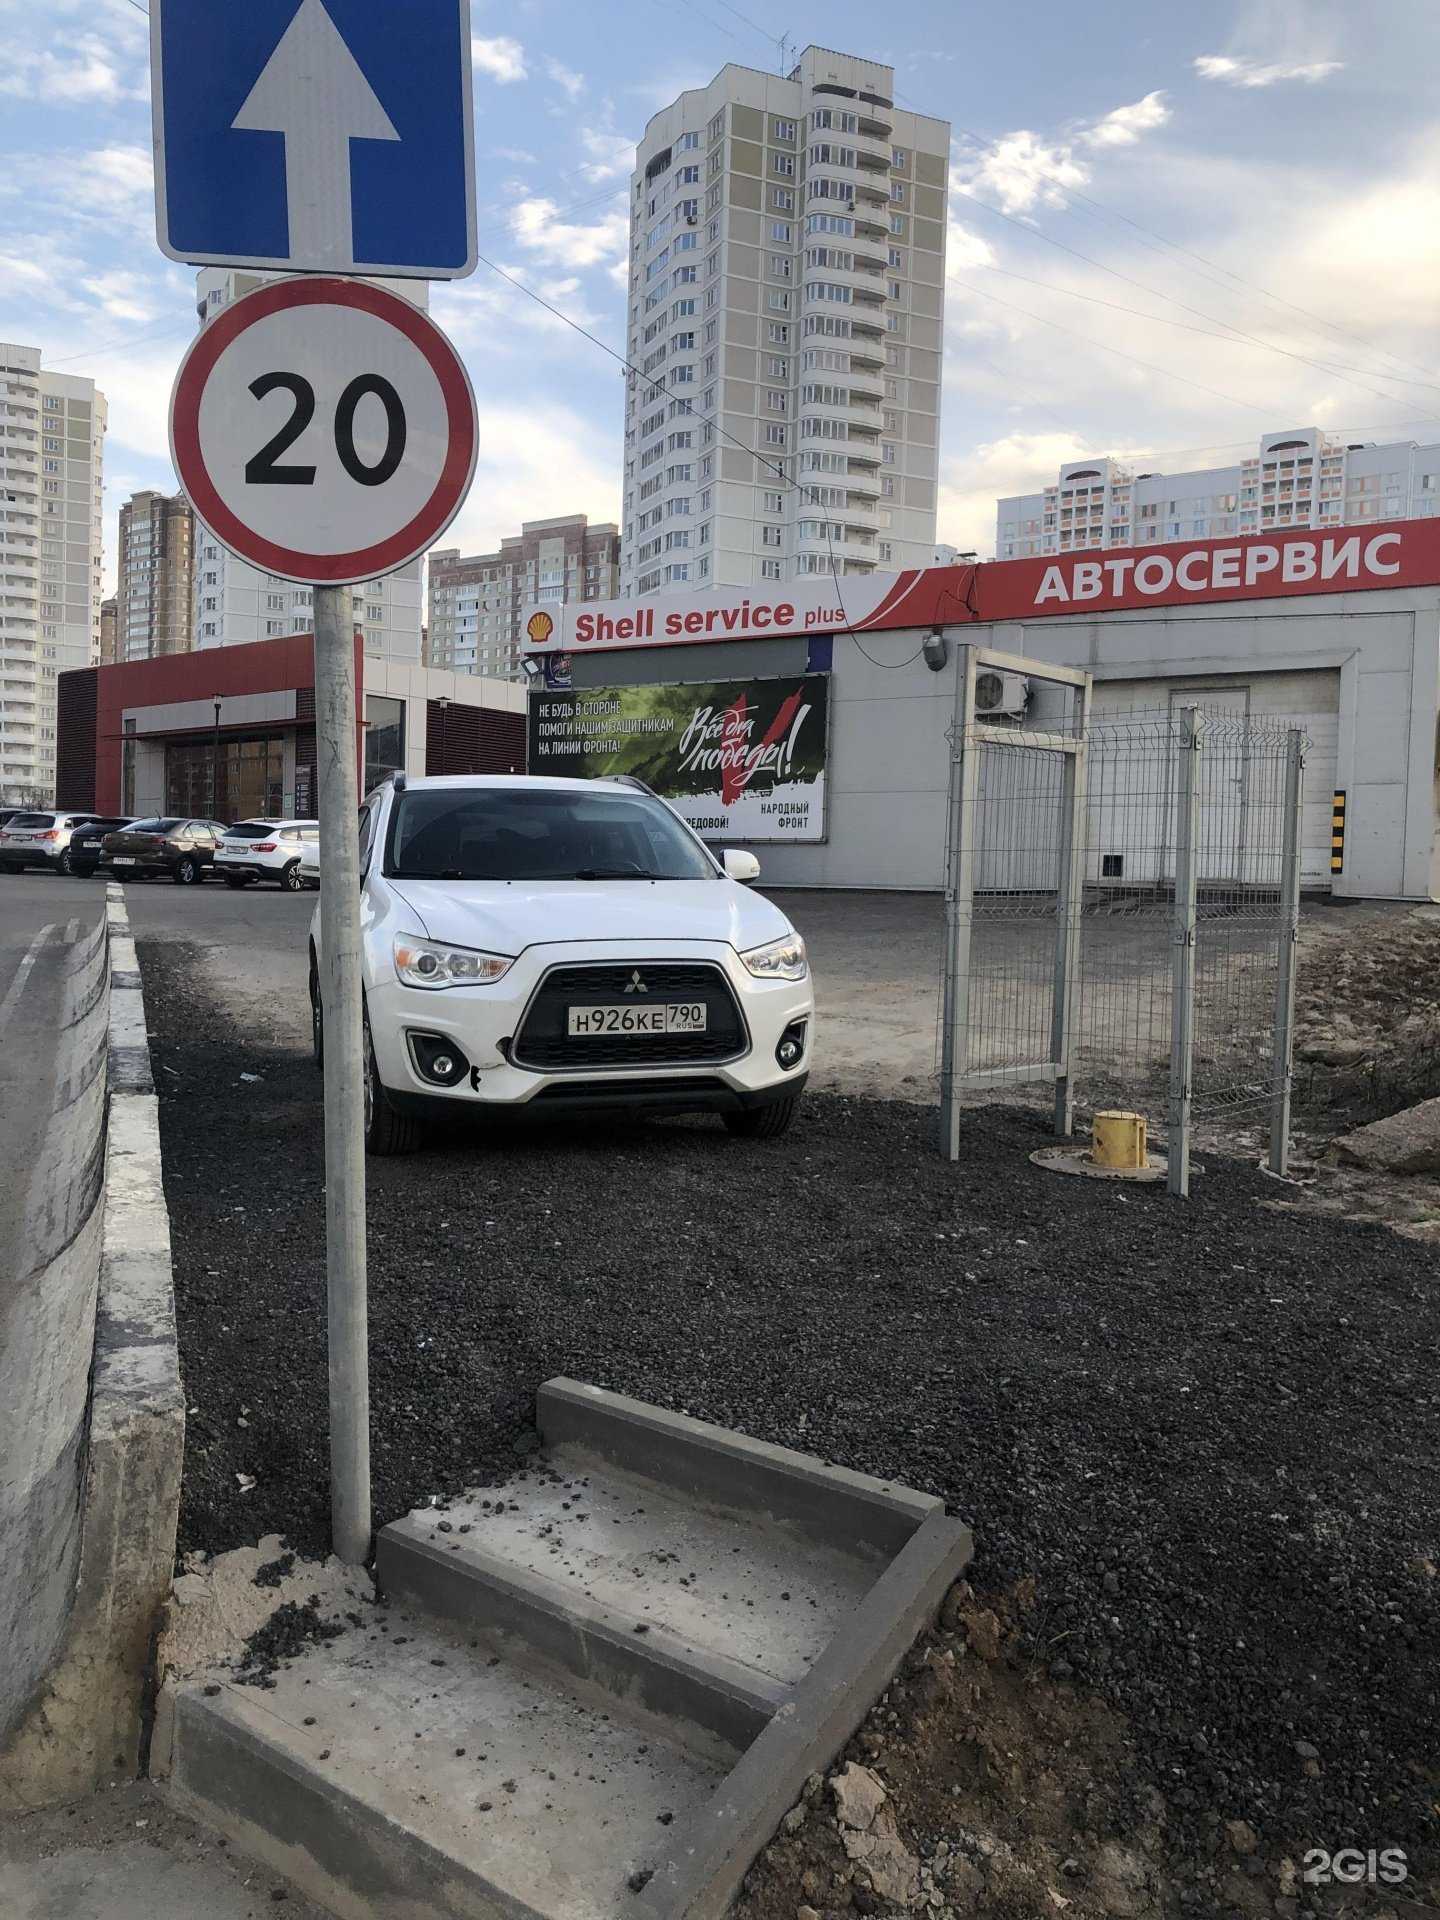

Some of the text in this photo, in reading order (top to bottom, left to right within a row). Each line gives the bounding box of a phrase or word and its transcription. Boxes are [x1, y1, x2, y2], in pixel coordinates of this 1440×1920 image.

[245, 371, 407, 486] 20
[1035, 532, 1402, 604] АВТОСЕРВИС
[575, 600, 846, 643] Shell service plus
[539, 704, 550, 718] НЕ
[551, 703, 574, 718] БУДЬ
[575, 702, 581, 715] В
[539, 718, 674, 737] ПОМОГИ НАШИМ ЗАЩИТНИКАМ
[538, 739, 621, 756] НА ЛИНИИ ФРОНТА!
[760, 801, 809, 815] НАРОДНЫЙ
[683, 815, 729, 831] РЕДОВОЙ!
[778, 817, 809, 829] ФРОНТ
[576, 1005, 702, 1032] Н926КЕ 790
